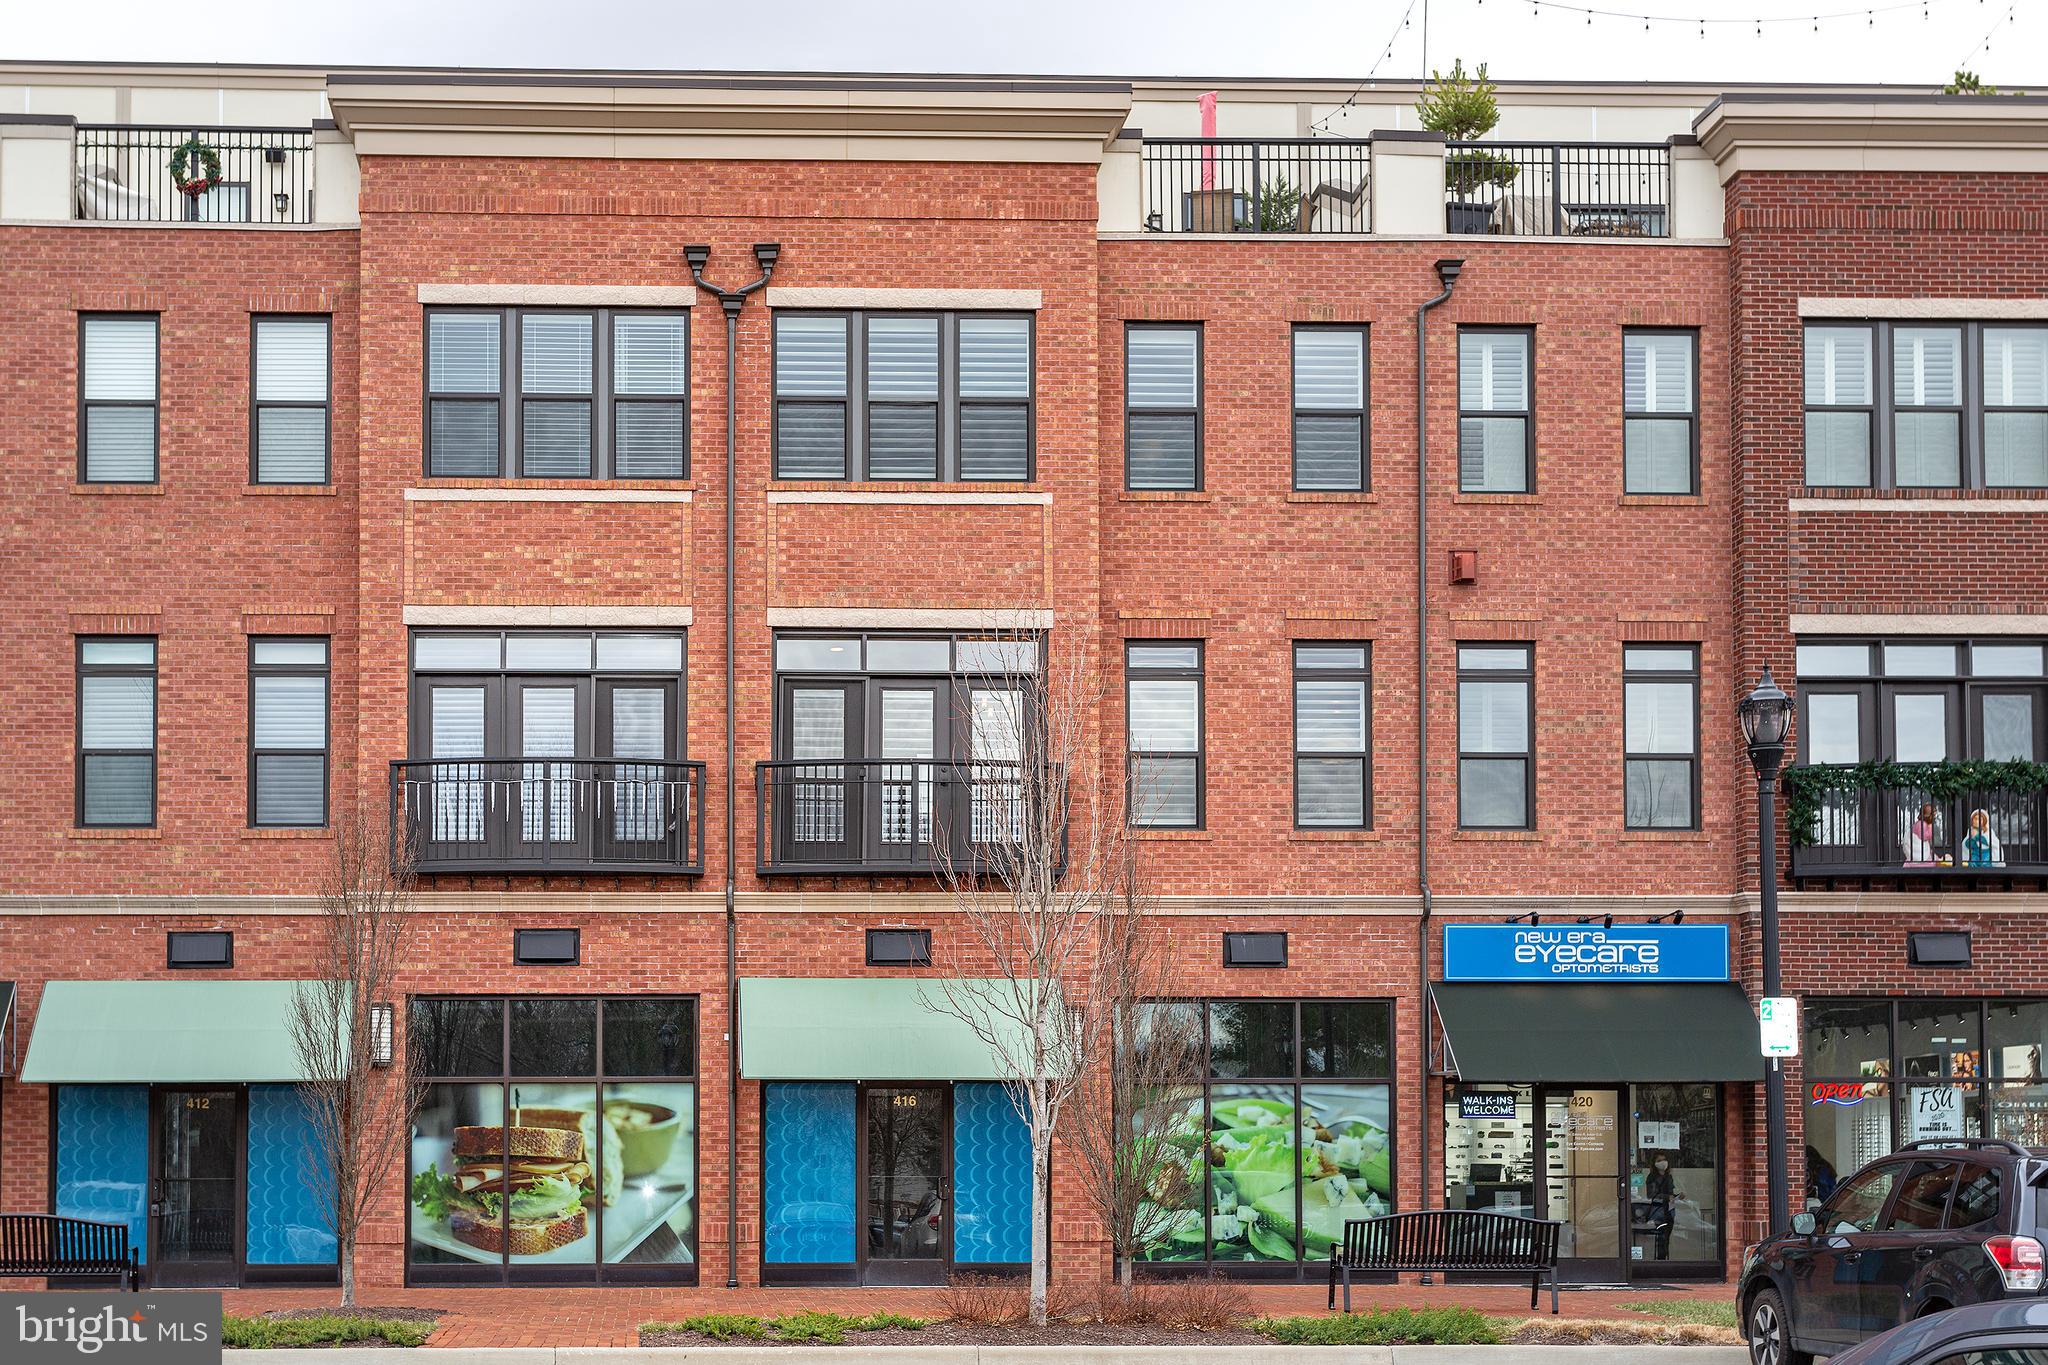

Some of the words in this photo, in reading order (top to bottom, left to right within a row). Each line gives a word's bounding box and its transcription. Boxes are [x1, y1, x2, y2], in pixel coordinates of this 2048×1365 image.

[1515, 931, 1561, 943] new
[1567, 931, 1606, 943] era
[1515, 944, 1659, 963] eyecare
[1551, 963, 1659, 973] OPTOMETRISTS
[1762, 1002, 1772, 1018] 2
[186, 1098, 210, 1109] 412
[893, 1095, 917, 1107] 416
[1462, 1096, 1514, 1105] WALK-INS
[1570, 1097, 1593, 1107] 420
[1919, 1087, 1954, 1113] FSA
[1463, 1106, 1515, 1115] WELCOME
